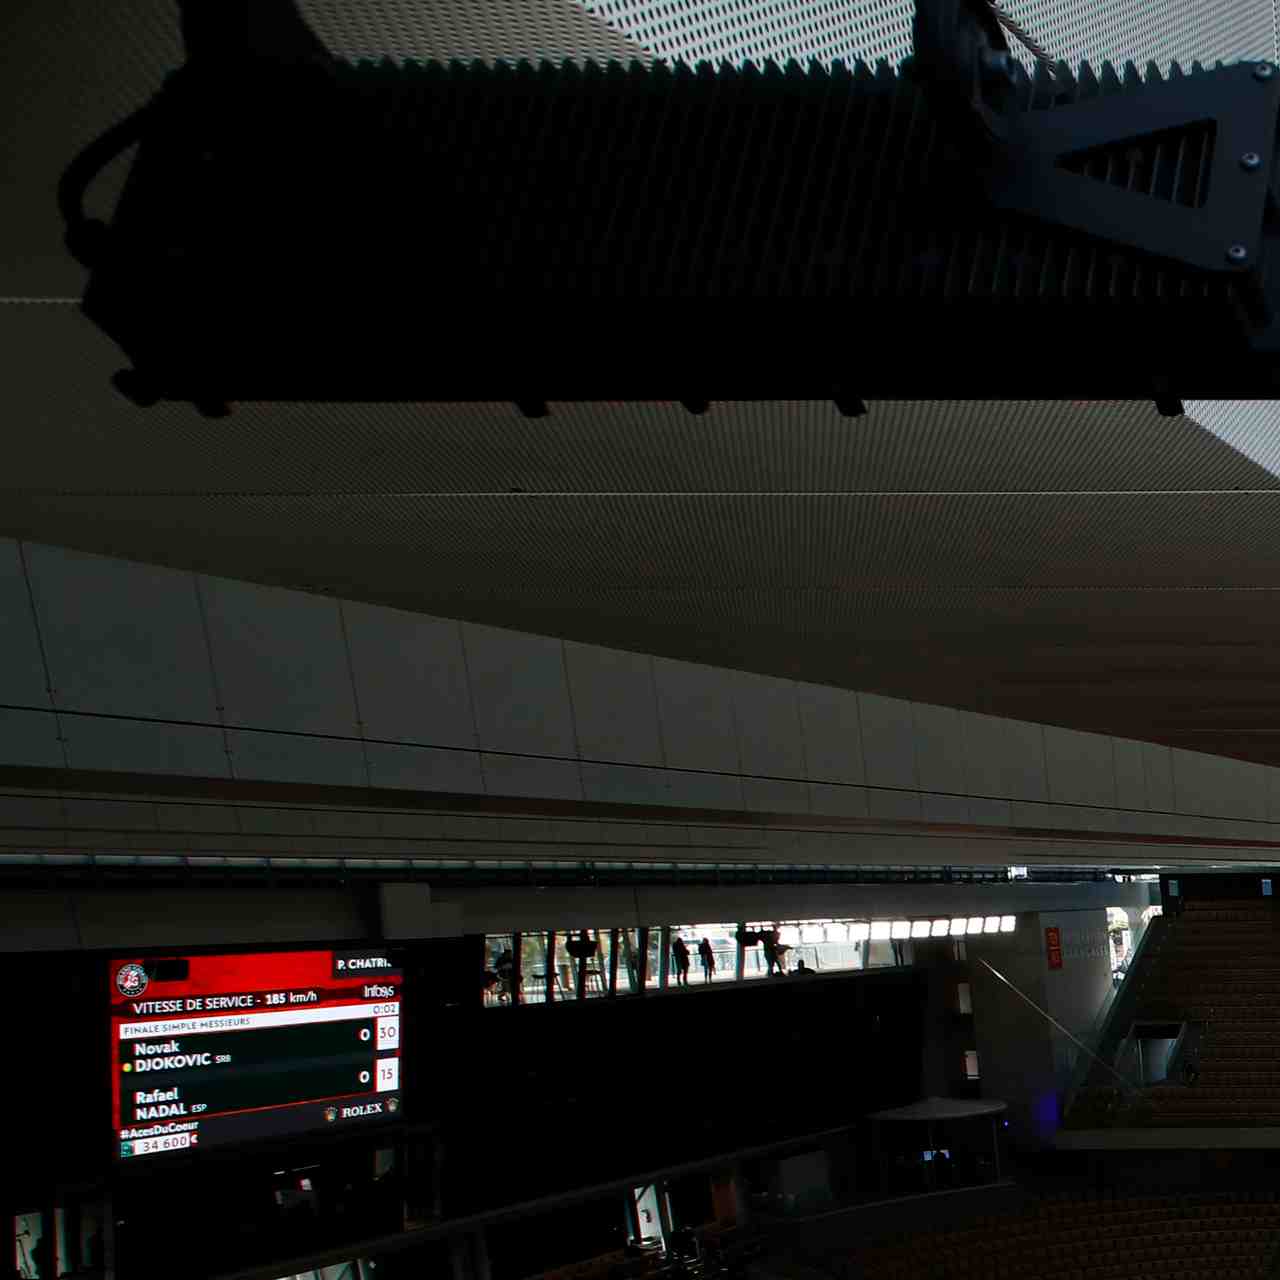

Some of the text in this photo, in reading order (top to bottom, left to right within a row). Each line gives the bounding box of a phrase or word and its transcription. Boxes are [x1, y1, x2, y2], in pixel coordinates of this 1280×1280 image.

[337, 958, 392, 970] P. CHATRI
[132, 1000, 184, 1015] VITESSE
[186, 997, 204, 1011] DE
[205, 995, 254, 1010] SERVICE
[265, 992, 286, 1006] 185
[289, 990, 317, 1005] km/h
[373, 1004, 396, 1014] 0:02
[124, 1017, 250, 1036] FINALE SIMPLE MESSIEURS
[135, 1040, 180, 1056] Novak
[135, 1026, 397, 1072] DJOKOVIC SRB 0 30
[135, 1088, 178, 1104] Rafael
[136, 1068, 394, 1121] NADAL ESP 0 15
[342, 1102, 383, 1119] ROLEX
[120, 1120, 199, 1139] #AcesDuCoeur
[143, 1141, 159, 1152] 34
[163, 1136, 187, 1148] 600
